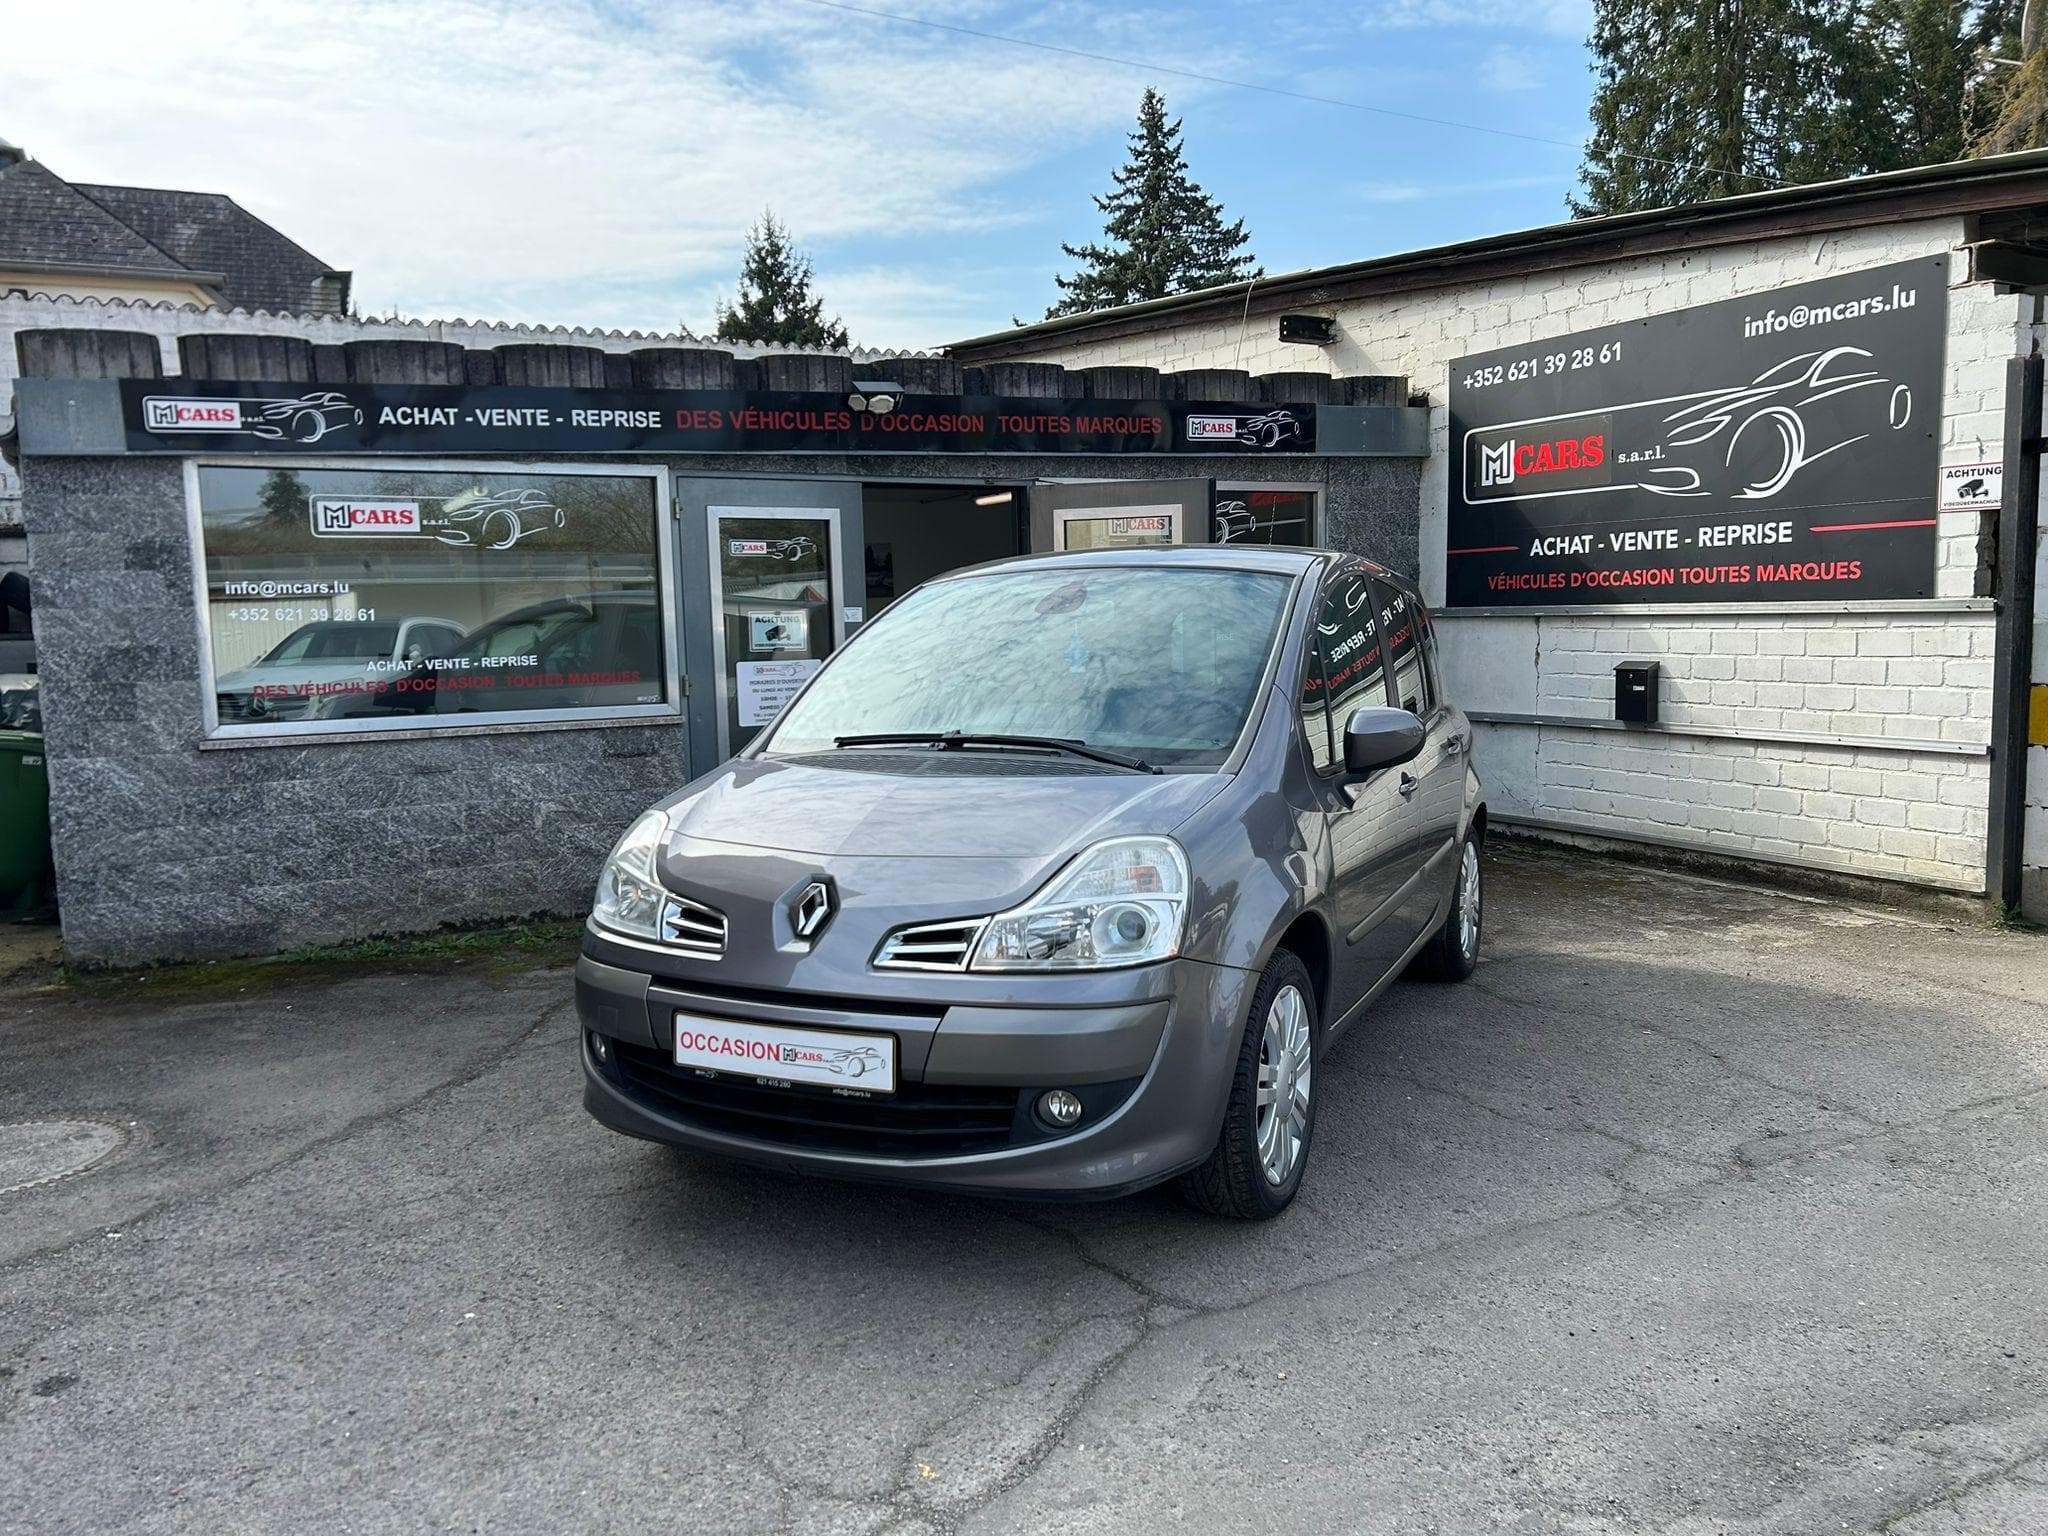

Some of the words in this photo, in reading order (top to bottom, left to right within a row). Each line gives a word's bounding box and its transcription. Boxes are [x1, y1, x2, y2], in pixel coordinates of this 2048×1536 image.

[1744, 284, 1916, 338] info@mcars.lu
[1463, 365, 1503, 389] +352
[1507, 358, 1538, 382] 621
[1544, 352, 1566, 375] 39
[1571, 347, 1594, 370] 28
[1599, 341, 1621, 364] 61
[378, 406, 458, 426] ACHAT
[475, 408, 550, 426] VENTE
[571, 409, 662, 428] REPRISE
[676, 409, 723, 430] DES
[729, 406, 851, 430] VÉHICULES
[861, 413, 984, 433] D'OCCASION
[998, 415, 1071, 433] TOUTES
[1075, 415, 1163, 434] MARQUES
[1946, 466, 2002, 479] ACHTUNG
[1530, 534, 1593, 558] ACHAT
[1609, 528, 1679, 552] VENTE
[1698, 521, 1793, 548] REPRISE
[224, 580, 350, 598] info@mcars.lu
[1488, 570, 1566, 590] VÉHICULES
[1570, 567, 1676, 588] D'OCCASION
[1680, 565, 1750, 586] TOUTES
[1756, 561, 1861, 583] MARQUES
[228, 607, 270, 622] +352
[274, 607, 303, 622] 621
[309, 607, 329, 622] 39
[333, 607, 353, 622] 28
[357, 607, 376, 622] 61
[366, 660, 414, 672] ACHAT
[424, 657, 470, 670] VENTE
[481, 655, 538, 668] REPRISE
[253, 684, 289, 699] DES
[292, 680, 389, 697] VÉHICULES
[505, 672, 564, 689] TOUTES
[568, 671, 641, 686] MARQUES
[680, 1031, 780, 1061] OCCASION
